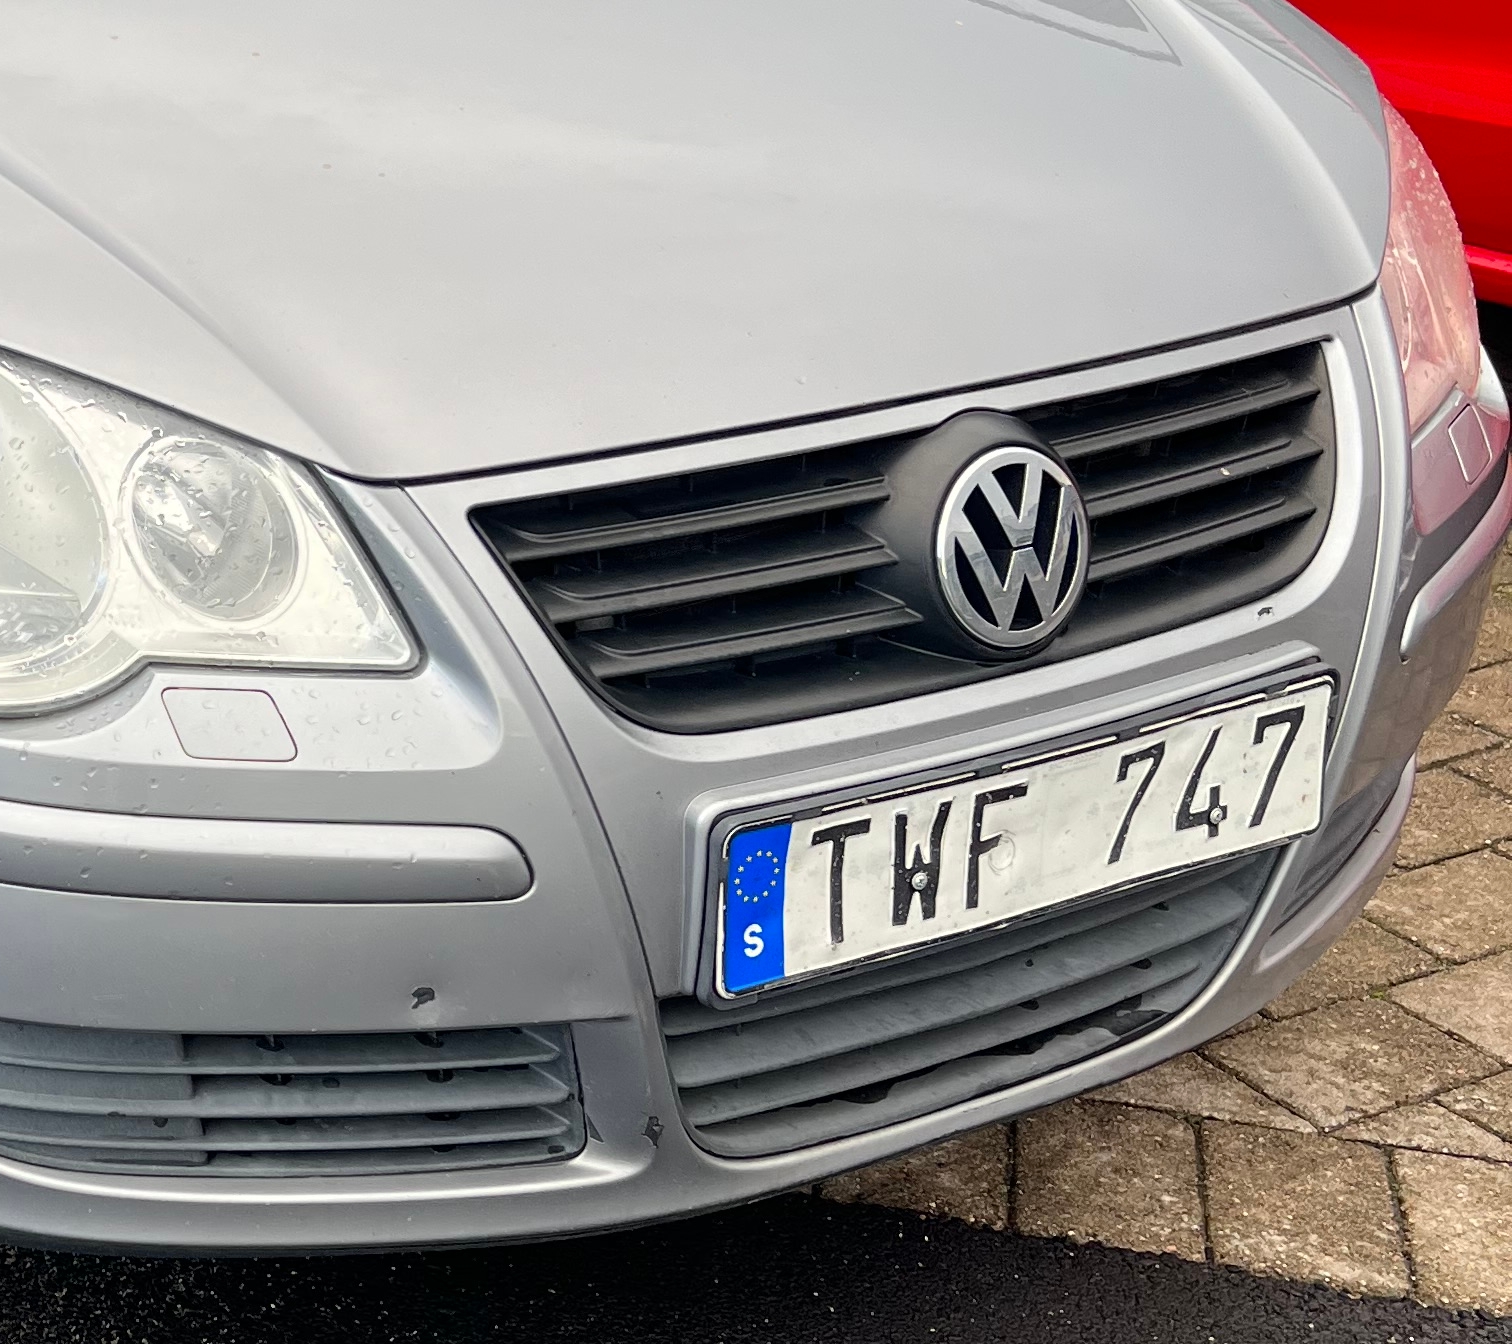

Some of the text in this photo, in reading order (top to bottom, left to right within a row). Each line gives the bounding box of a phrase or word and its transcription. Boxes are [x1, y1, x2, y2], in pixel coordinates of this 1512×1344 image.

[938, 445, 1088, 648] VW
[811, 705, 1305, 943] TWF 747
[743, 923, 765, 958] S
